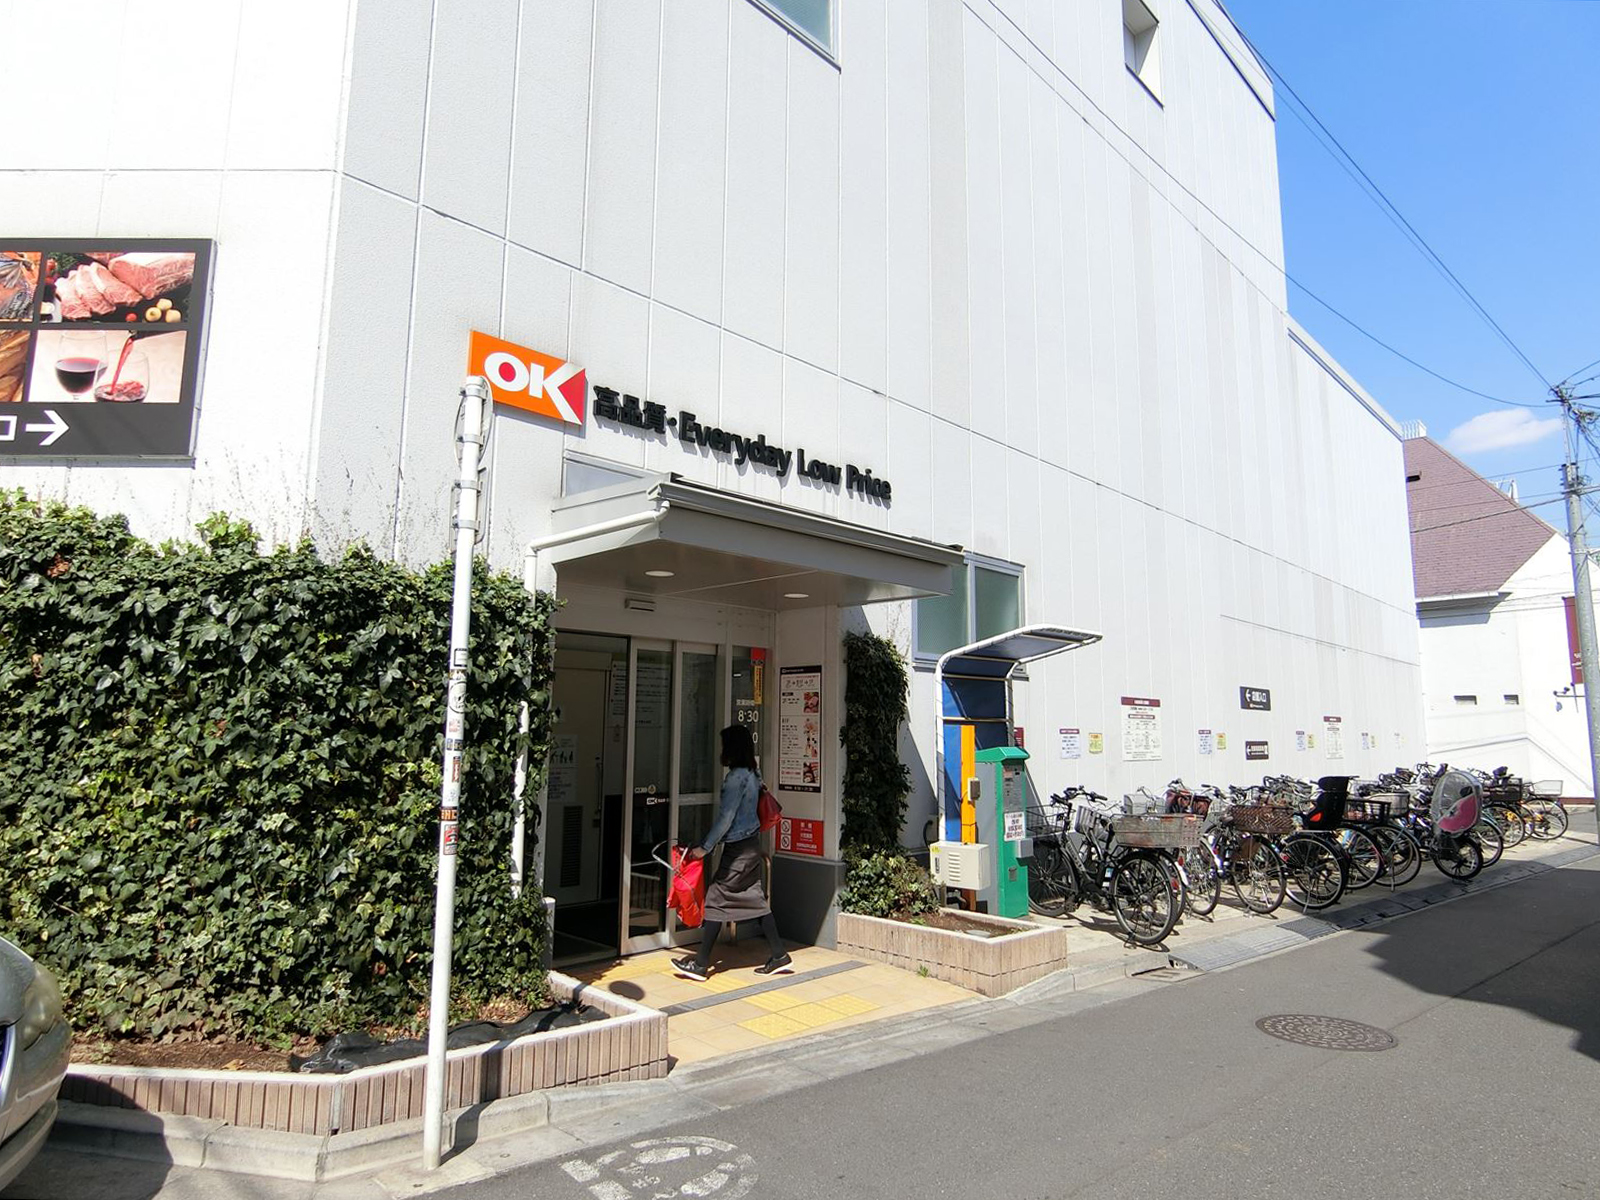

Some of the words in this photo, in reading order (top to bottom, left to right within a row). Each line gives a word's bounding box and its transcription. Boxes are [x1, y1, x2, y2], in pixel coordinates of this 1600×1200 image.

[483, 351, 586, 425] OK
[797, 448, 842, 485] Low
[846, 464, 892, 500] Price
